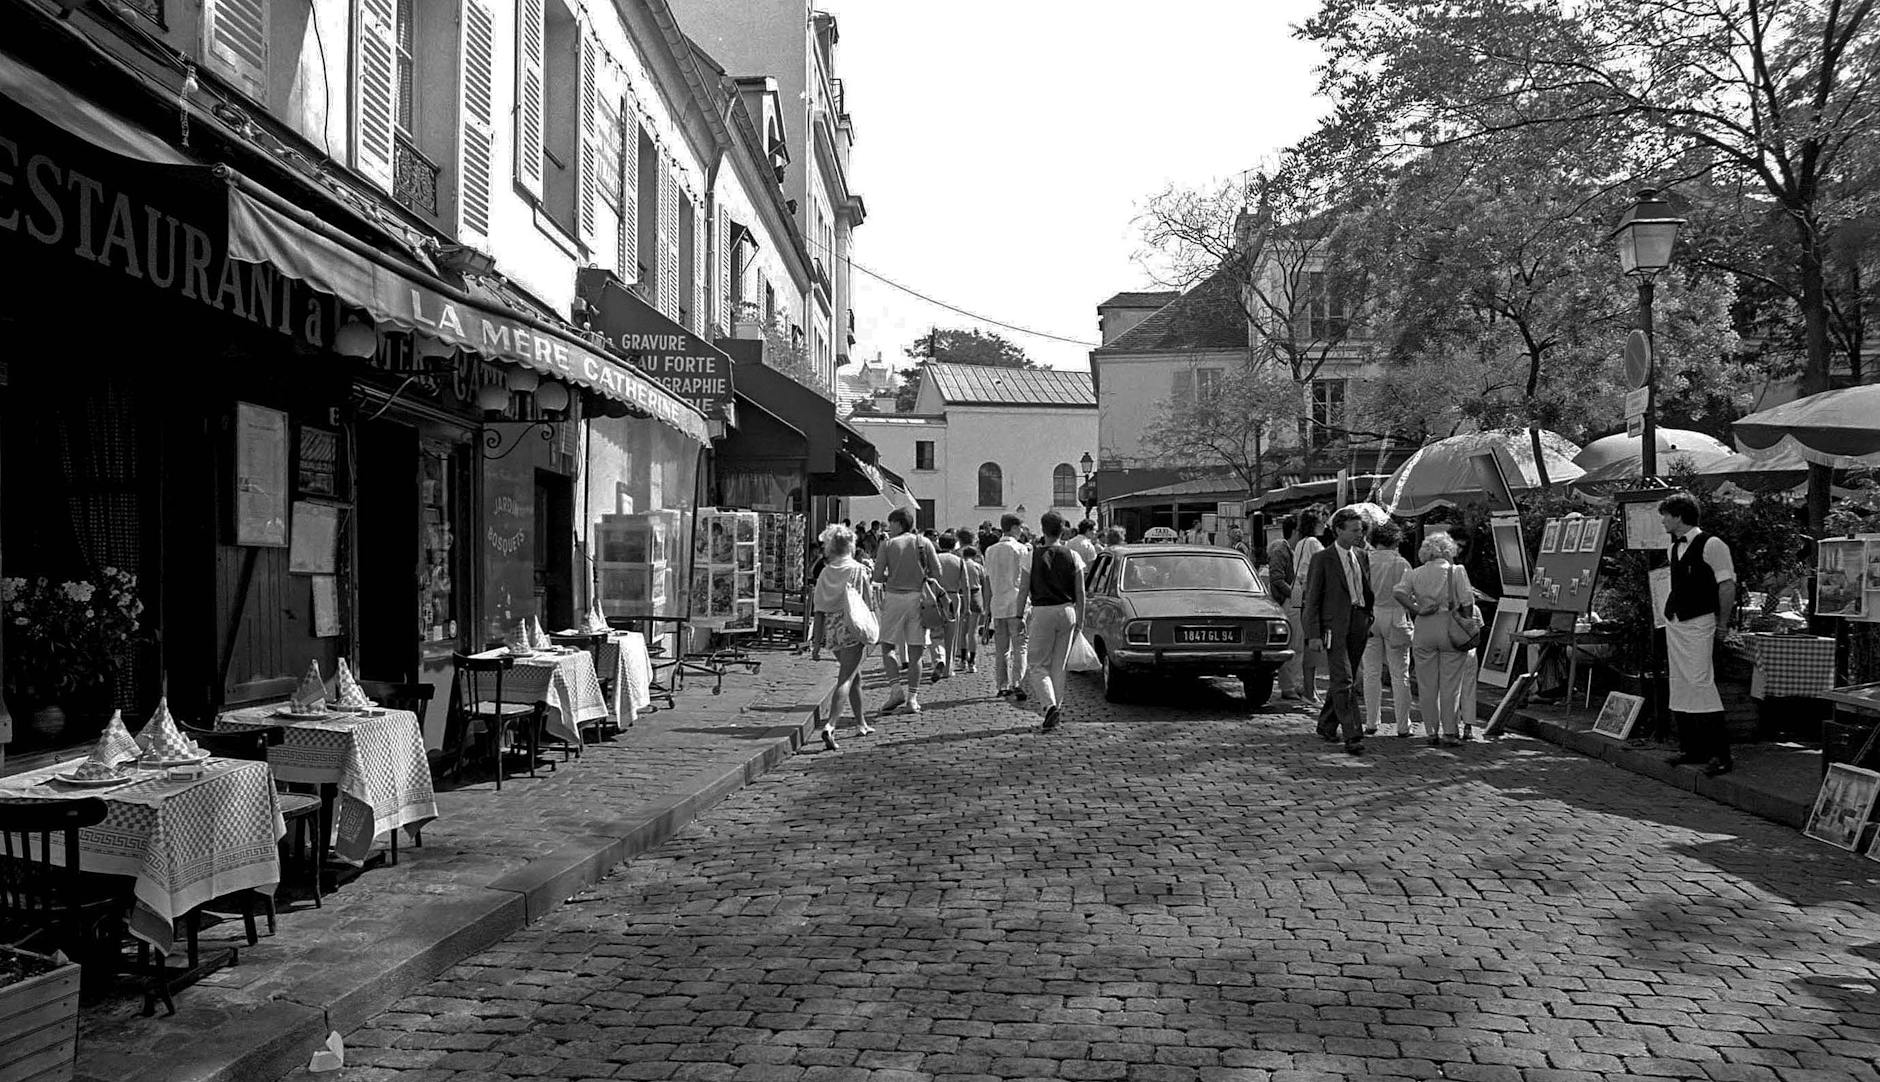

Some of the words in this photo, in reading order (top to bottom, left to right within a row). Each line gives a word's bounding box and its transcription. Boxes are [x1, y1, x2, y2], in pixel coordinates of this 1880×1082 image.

[621, 333, 687, 351] GRAVURE
[410, 288, 466, 338] LA
[583, 357, 679, 423] CATHERINE
[664, 356, 716, 373] FORTE
[1183, 630, 1206, 641] 1847
[1208, 630, 1220, 641] GL
[1221, 630, 1234, 641] 94
